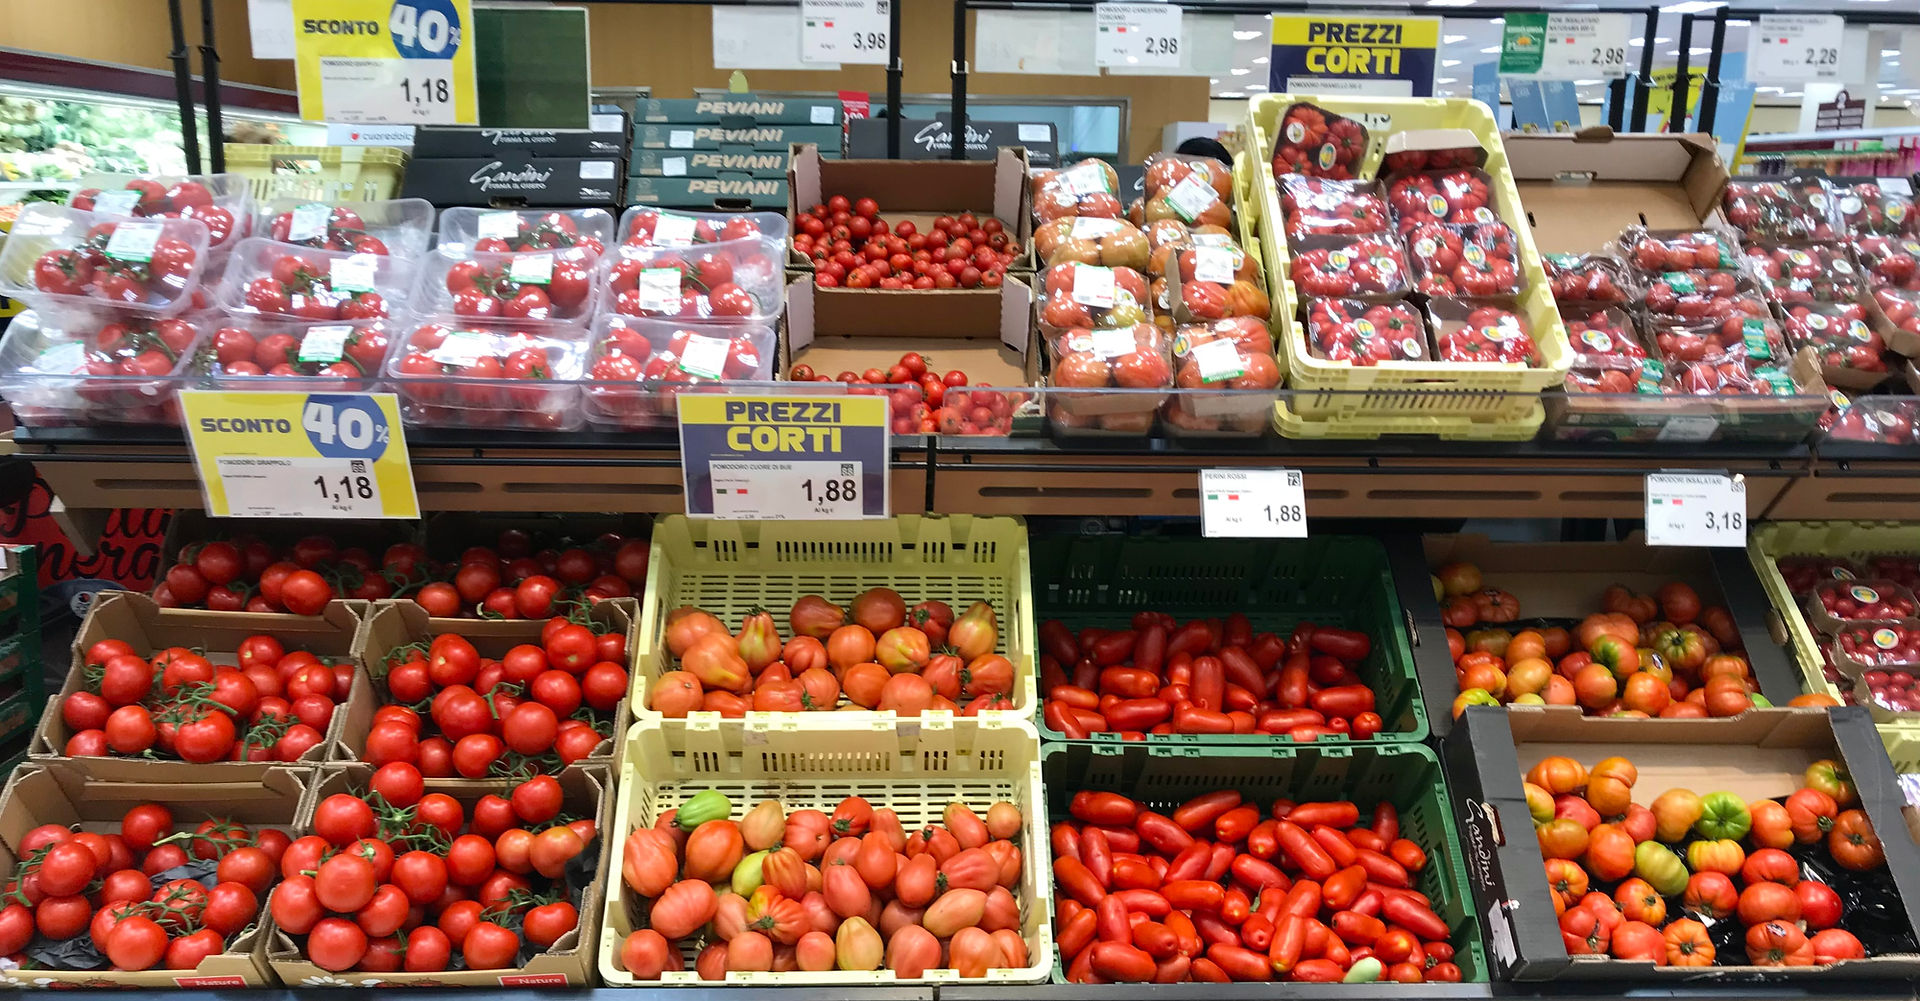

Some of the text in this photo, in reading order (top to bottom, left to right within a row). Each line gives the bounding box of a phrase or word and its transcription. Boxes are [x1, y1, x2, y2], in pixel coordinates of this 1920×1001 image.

[303, 19, 379, 36] SCONTO
[1308, 22, 1403, 44] PREZZI
[853, 32, 886, 51] 3,98
[1145, 37, 1178, 55] 2,98
[1305, 46, 1401, 75] CORTI
[1591, 48, 1624, 65] 2,98
[1805, 48, 1837, 66] 2,28
[400, 78, 449, 106] 1,18
[696, 101, 785, 116] PEVIANI
[691, 127, 783, 143] PEVIANI
[690, 153, 782, 170] PEVIANI
[469, 161, 553, 192] Gandini
[687, 180, 779, 195] PEVIANI
[725, 401, 841, 423] PREZZI
[200, 417, 291, 434] SCONTO
[726, 426, 842, 453] CORTI
[749, 463, 772, 471] CUORE
[1204, 472, 1226, 480] PERINI
[314, 475, 374, 502] 1,18
[801, 478, 857, 505] 1,88
[1263, 504, 1301, 525] 1,88
[1705, 511, 1742, 532] 3,18
[1465, 798, 1496, 887] Gandini
